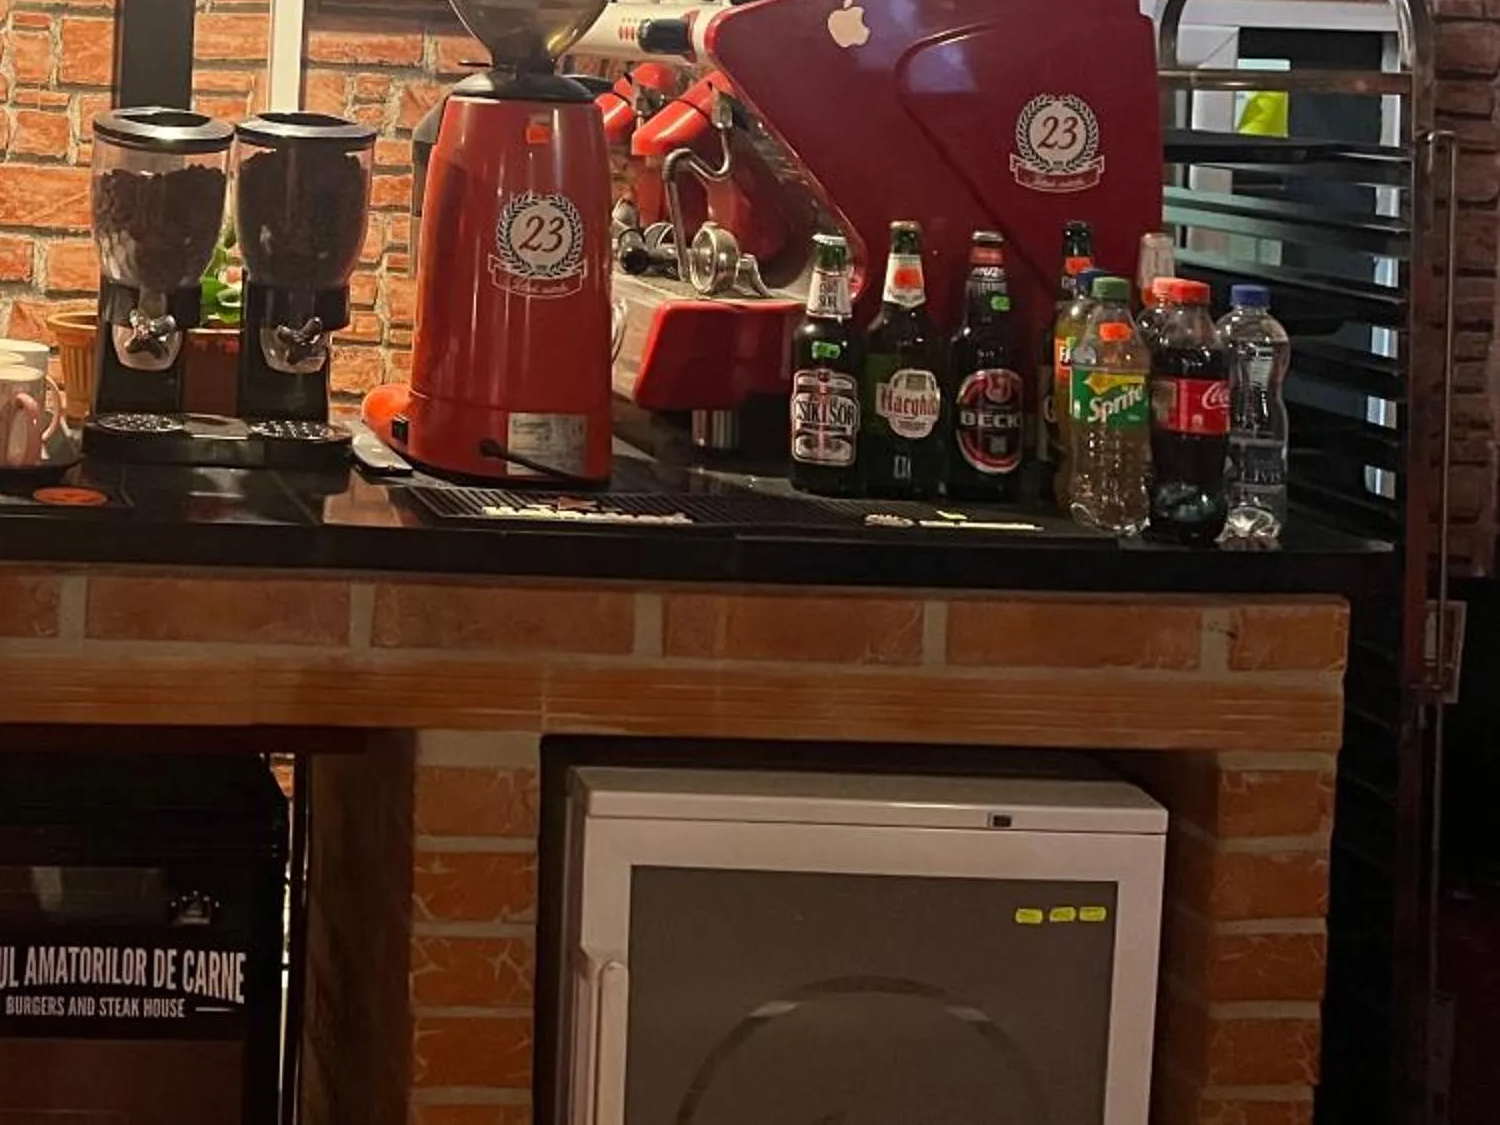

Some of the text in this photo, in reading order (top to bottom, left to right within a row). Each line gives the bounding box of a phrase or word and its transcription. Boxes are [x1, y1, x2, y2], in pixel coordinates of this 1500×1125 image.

[1037, 116, 1079, 150] 23
[518, 216, 565, 252] 23
[23, 945, 147, 987] AMATORILOR
[153, 948, 177, 990] DE
[182, 950, 246, 1004] CARNE
[5, 995, 187, 1019] BURGERS AND STEAK HOUSE
